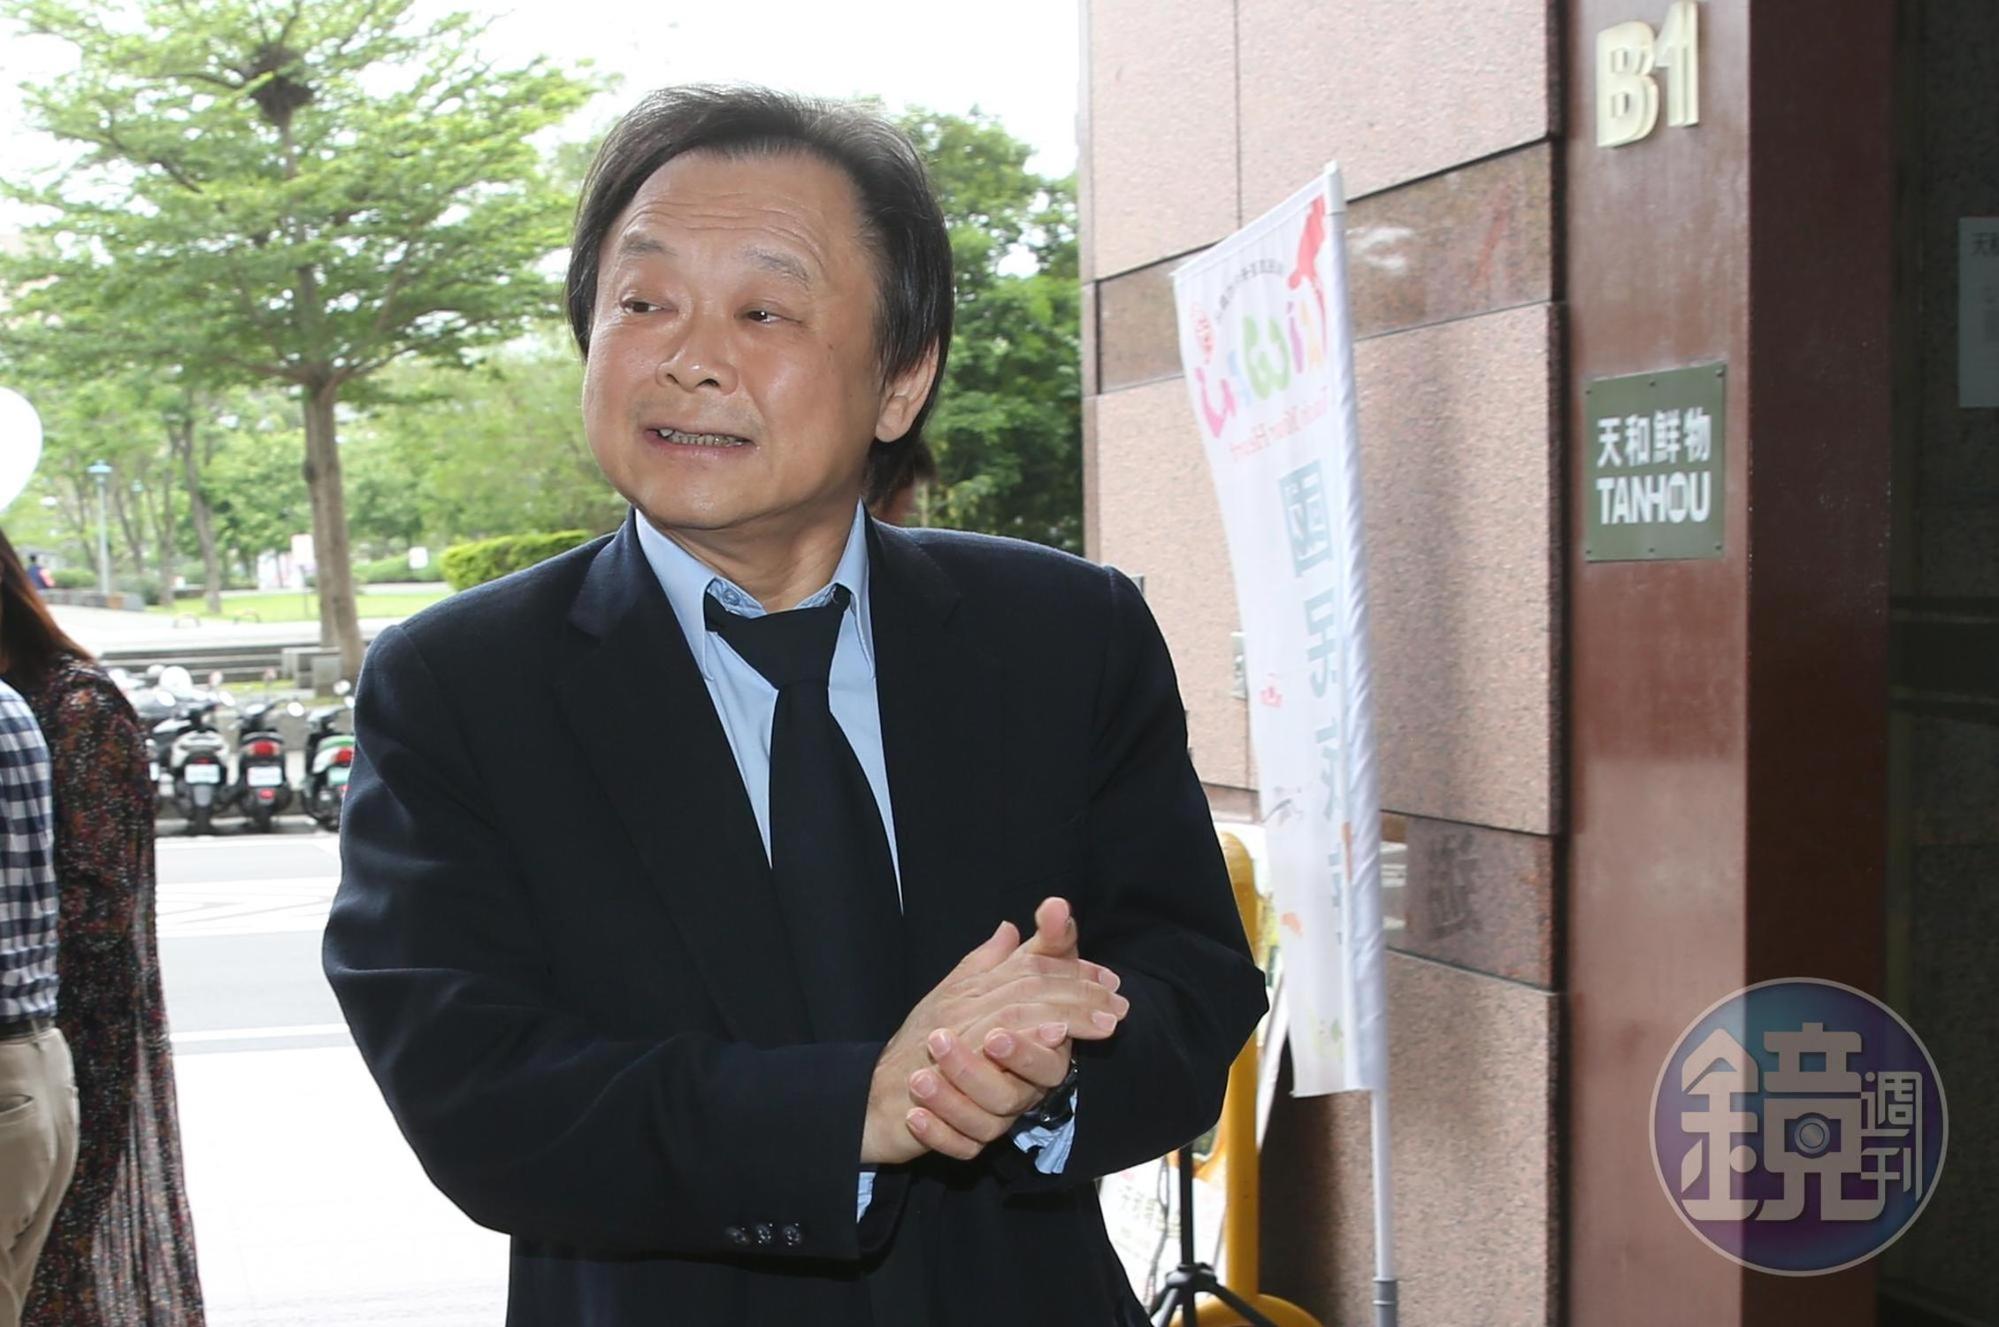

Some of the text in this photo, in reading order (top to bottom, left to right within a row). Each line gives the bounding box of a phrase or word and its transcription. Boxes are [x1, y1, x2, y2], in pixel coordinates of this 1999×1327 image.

[1596, 0, 1699, 147] B1
[1597, 407, 1712, 467] 天和鮮物
[1596, 471, 1712, 525] TANHOU
